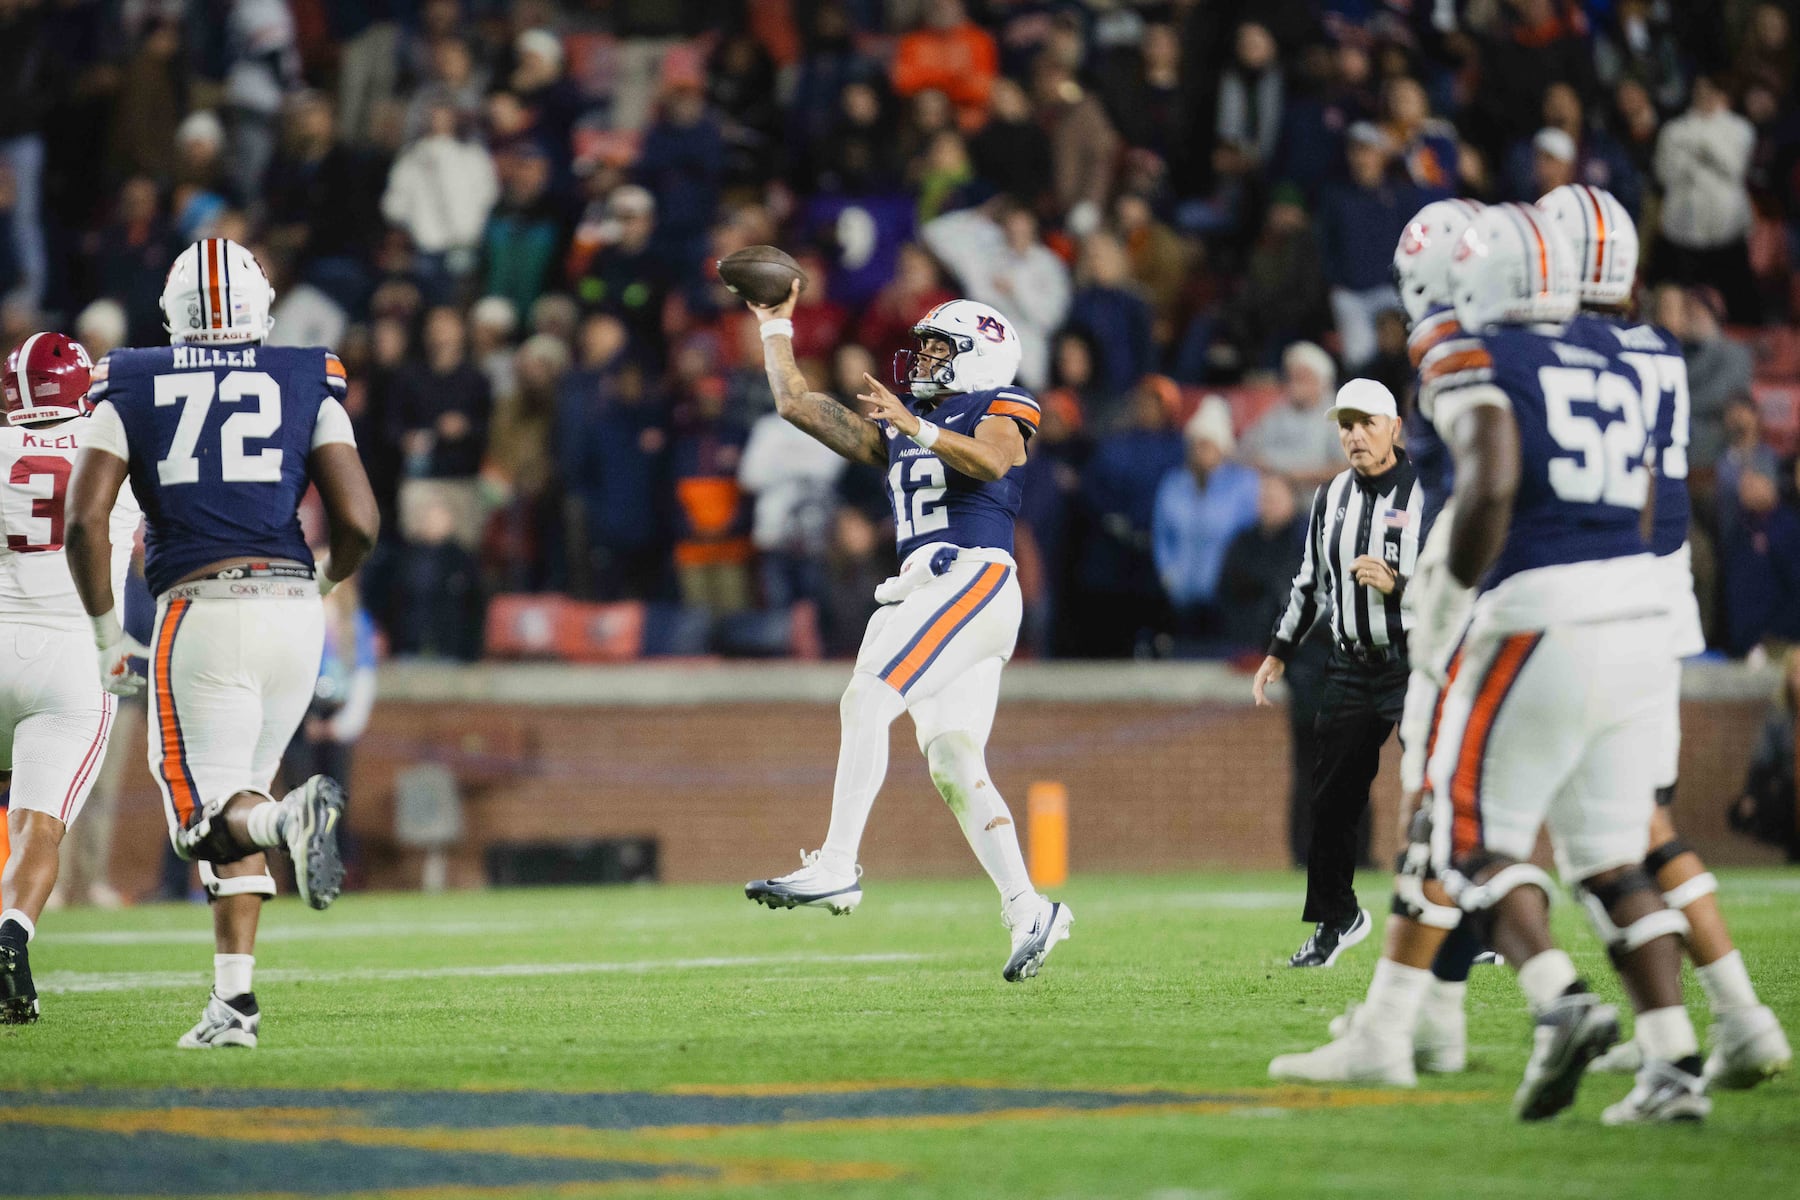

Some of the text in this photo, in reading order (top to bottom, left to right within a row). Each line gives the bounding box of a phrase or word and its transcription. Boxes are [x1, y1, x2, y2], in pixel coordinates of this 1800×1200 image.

[173, 346, 257, 369] MILLER
[184, 331, 253, 343] WAR EAGLE
[154, 371, 283, 487] 72
[1537, 365, 1650, 511] 52
[888, 458, 949, 542] 12
[1384, 541, 1399, 561] R
